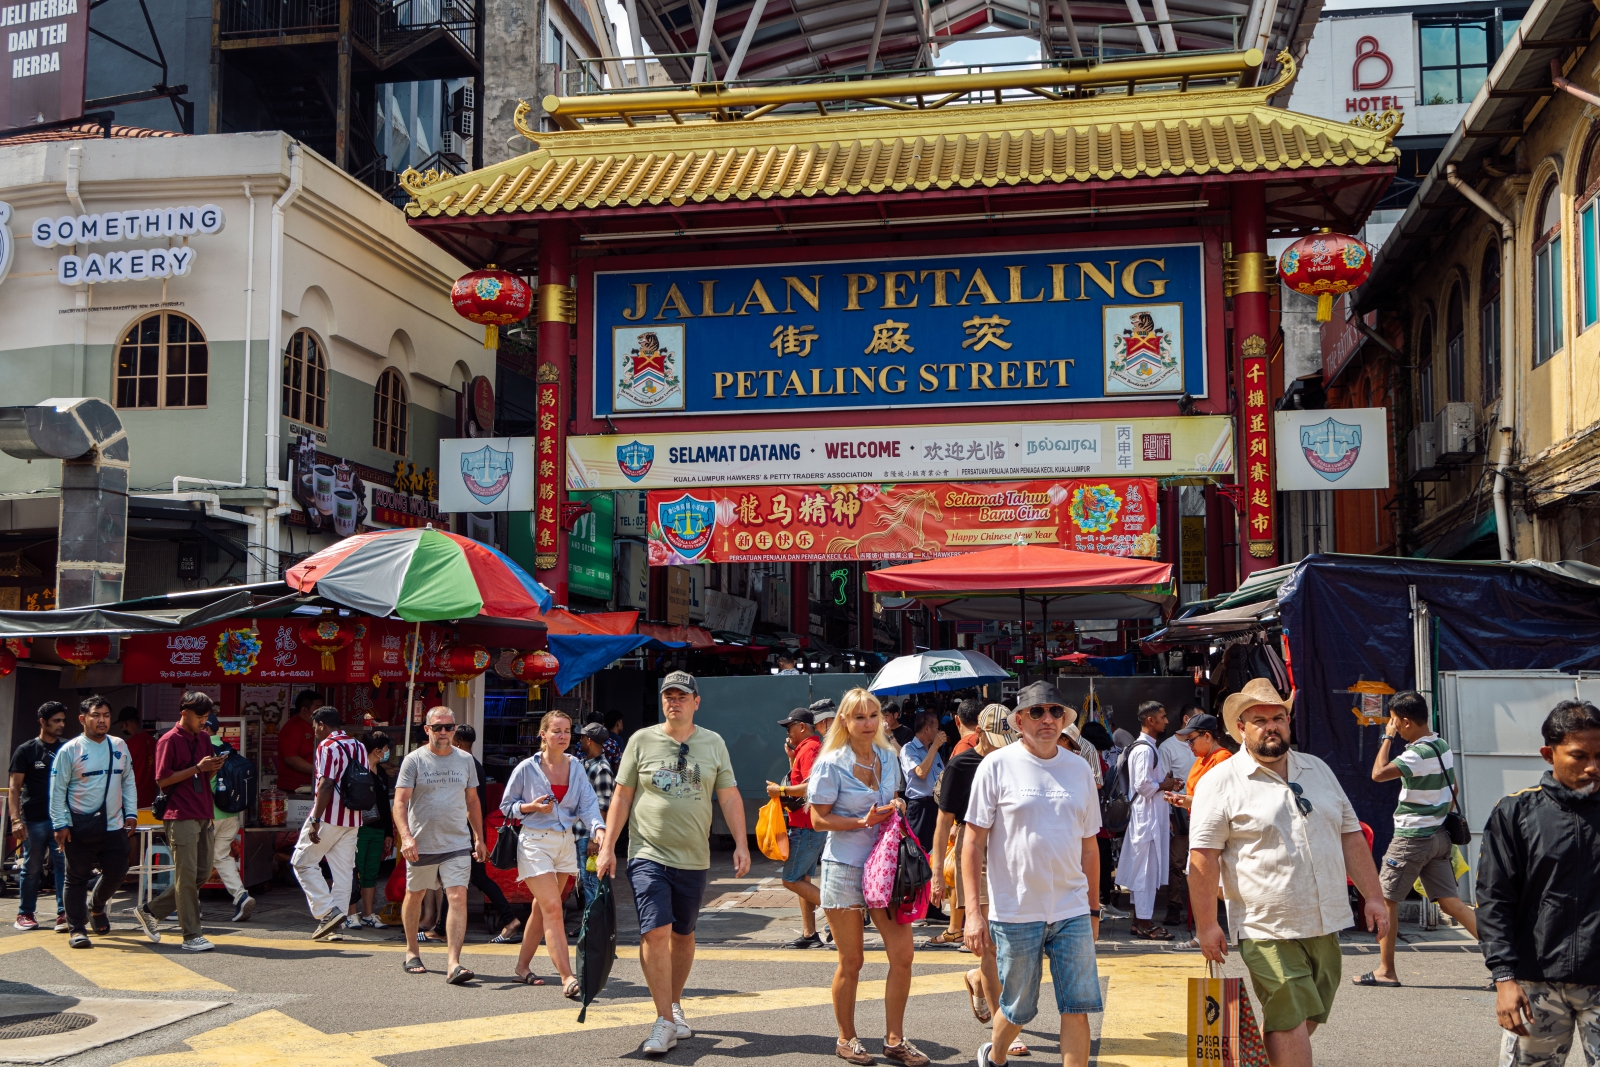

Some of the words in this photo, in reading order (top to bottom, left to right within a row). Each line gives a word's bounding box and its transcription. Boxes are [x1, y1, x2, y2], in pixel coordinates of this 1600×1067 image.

[0, 4, 27, 27] JELI
[30, 0, 78, 21] HERBA
[8, 29, 37, 52] DAN
[41, 23, 67, 46] TEH
[13, 52, 60, 78] HERBA
[1345, 95, 1403, 112] HOTEL
[37, 209, 217, 241] SOMETHING
[63, 252, 188, 278] BAKERY
[622, 274, 824, 321] JALAN
[842, 257, 1170, 312] PETALING
[712, 365, 908, 400] PETALING
[919, 359, 1075, 392] STREET
[668, 445, 737, 464] SELAMAT
[739, 443, 800, 462] DATANG
[824, 441, 900, 460] WELCOME
[923, 440, 1006, 461] 欢迎光临
[1026, 436, 1097, 456] நல்வரவு
[1116, 426, 1132, 469] 丙申年
[1246, 363, 1270, 534] 千攤並列賽超市
[792, 472, 826, 480] TRADERS'
[827, 471, 873, 479] ASSOCIATION
[961, 468, 989, 476] PERSATUAN
[989, 467, 1009, 475] PENJAJA
[1020, 466, 1041, 474] PENIAGA
[1071, 465, 1091, 473] LUMPUR
[375, 488, 407, 512] KOONG
[409, 496, 429, 518] WOH
[945, 490, 1004, 508] Selamat
[1005, 489, 1051, 507] Tahun
[735, 492, 863, 528] 龍马精神
[979, 506, 1016, 522] Baru
[1016, 504, 1051, 521] Cina
[620, 516, 631, 527] TEL
[736, 532, 813, 549] 新年快乐
[951, 532, 979, 544] Happy
[980, 531, 1011, 542] Chinese
[1014, 530, 1033, 540] New
[1034, 529, 1053, 540] Year
[167, 635, 208, 650] LOONG
[170, 652, 201, 665] KEE
[1196, 1035, 1229, 1048] PASAR
[1196, 1047, 1230, 1061] BESAR
